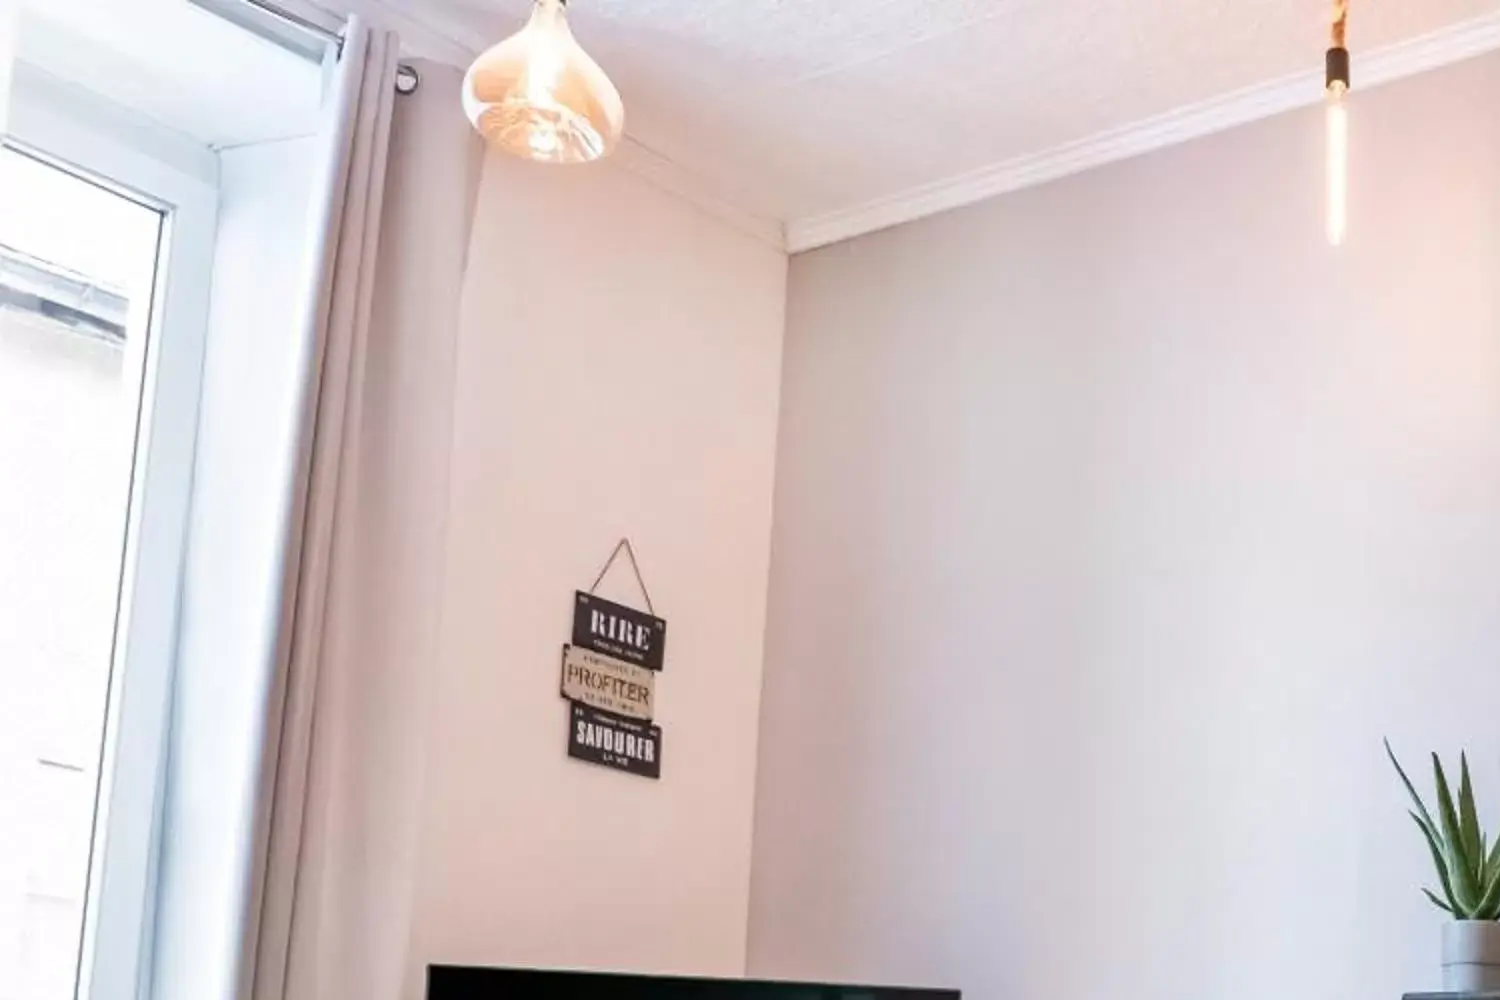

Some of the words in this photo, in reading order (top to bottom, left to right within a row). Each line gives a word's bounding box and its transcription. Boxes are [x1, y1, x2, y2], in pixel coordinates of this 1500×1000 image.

[591, 609, 651, 650] RIRE
[567, 663, 649, 705] PROFITER
[576, 720, 654, 762] SAVOURER
